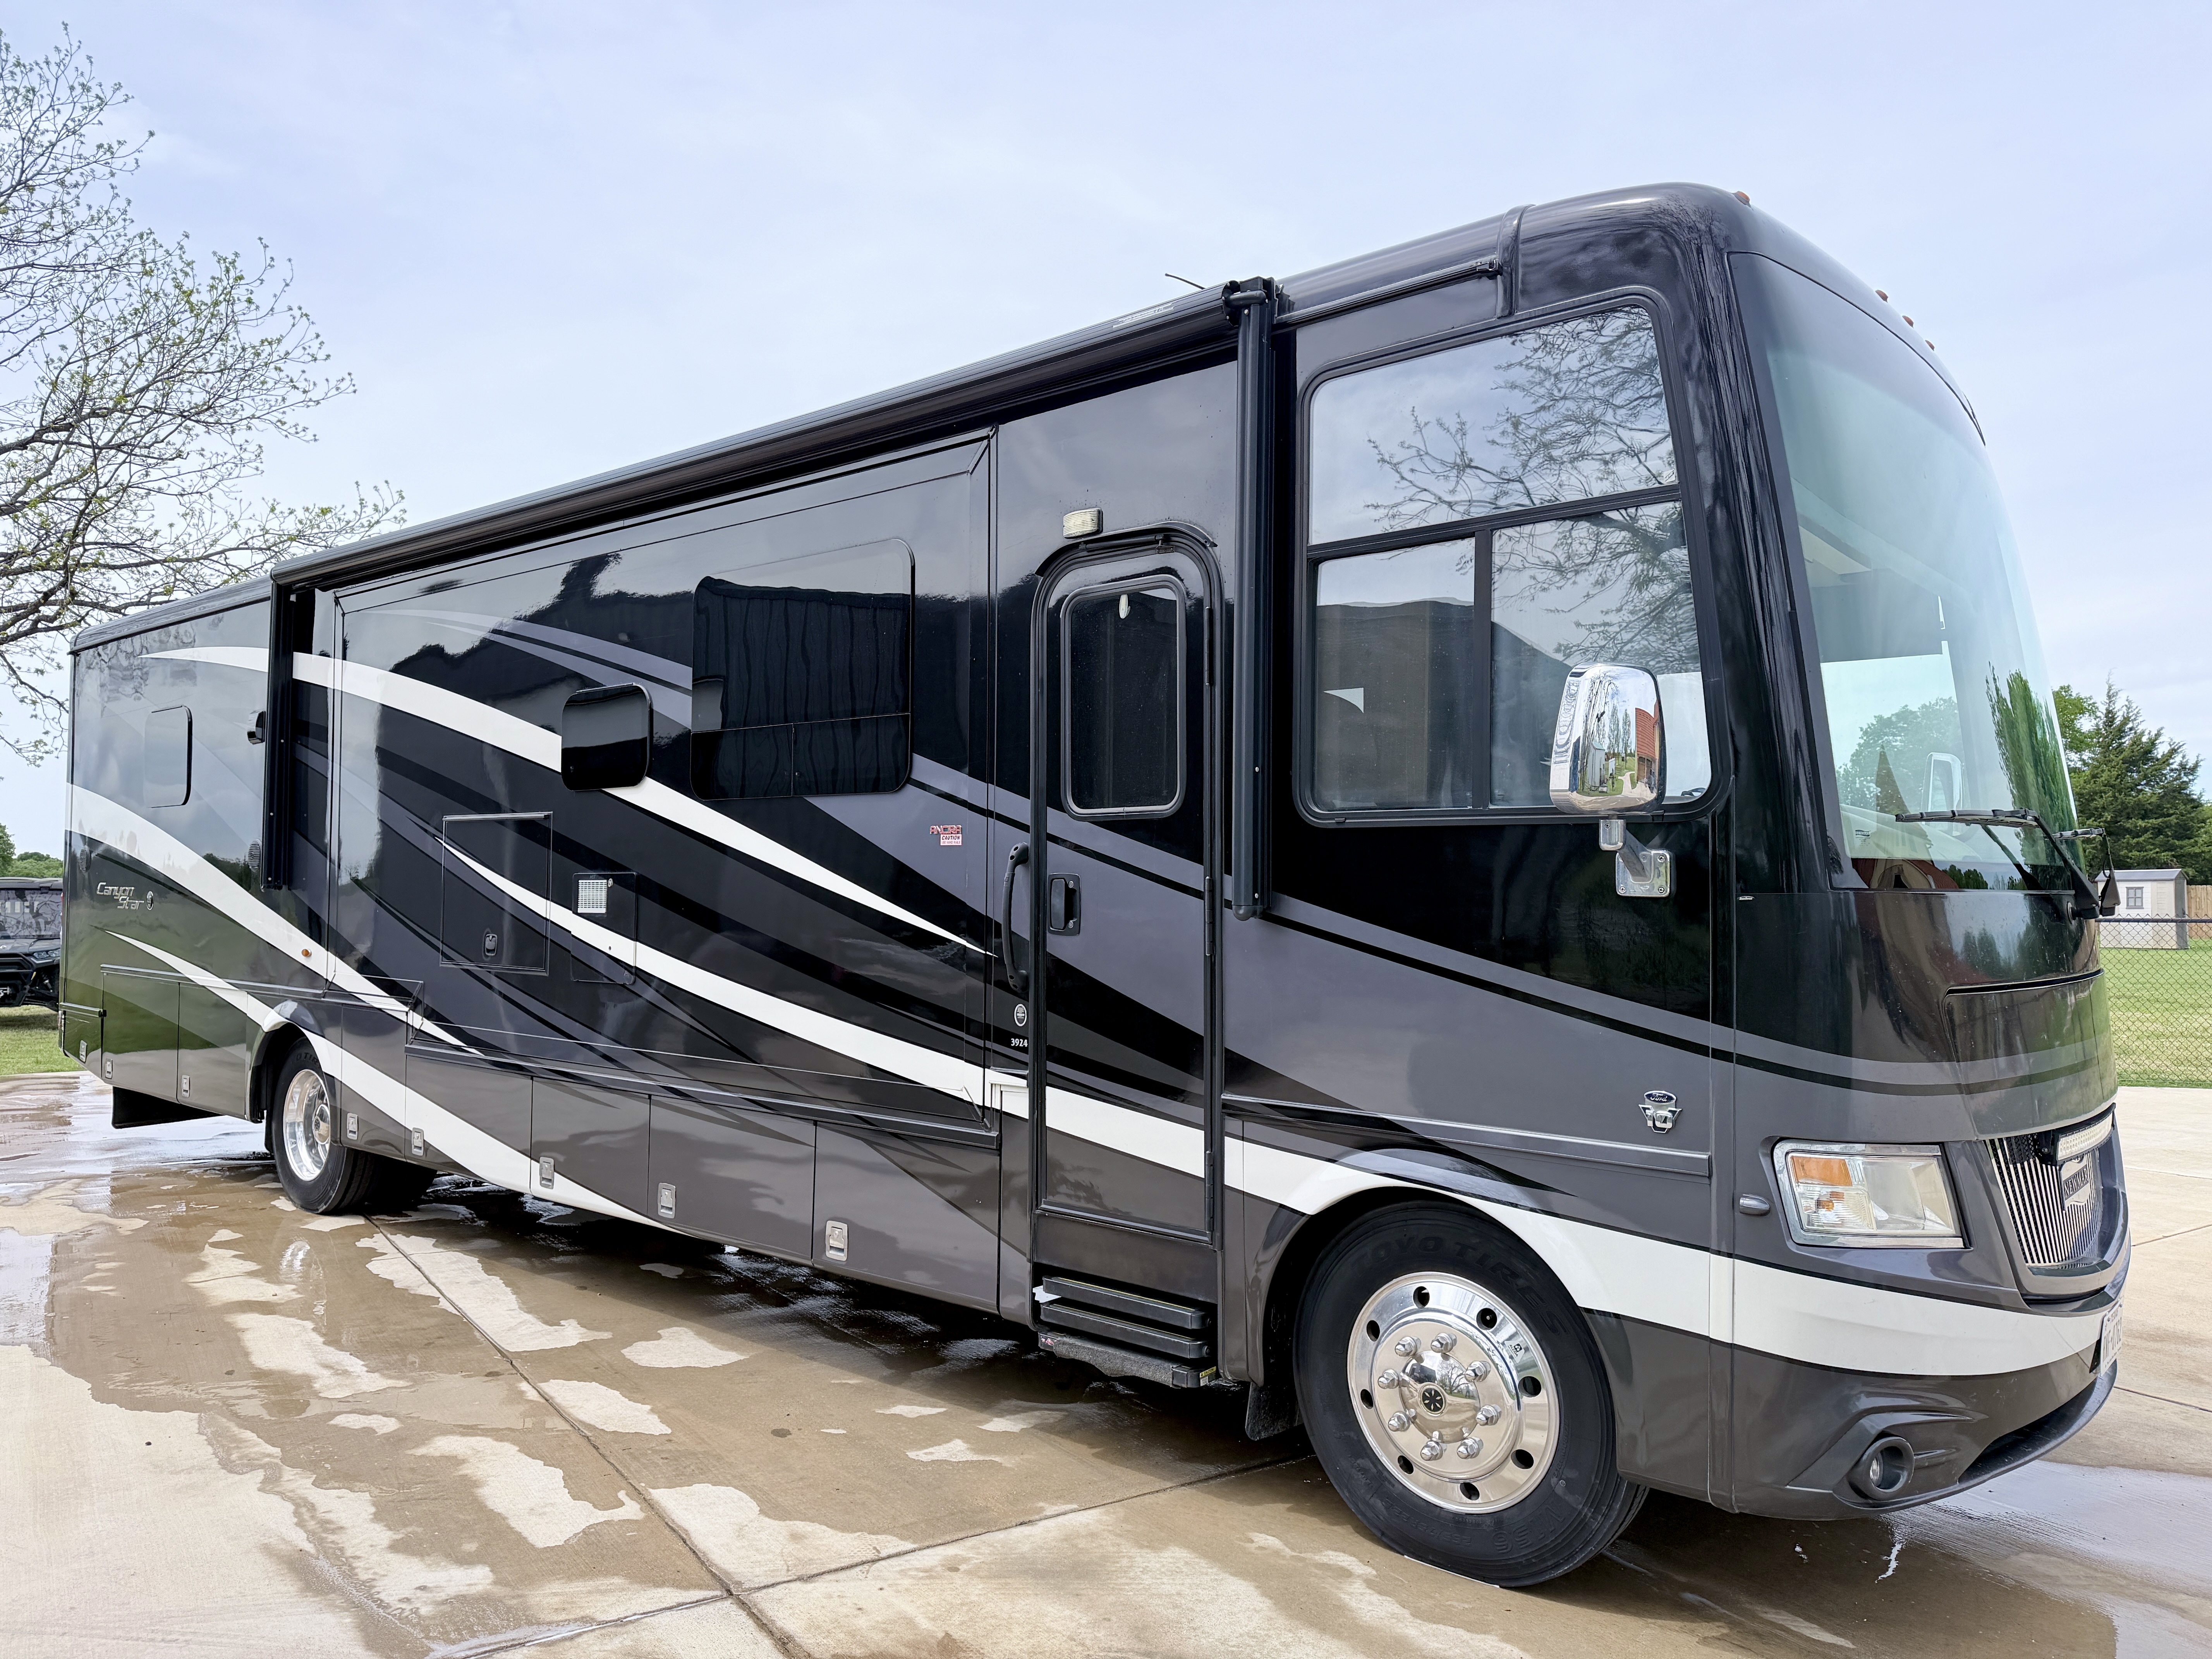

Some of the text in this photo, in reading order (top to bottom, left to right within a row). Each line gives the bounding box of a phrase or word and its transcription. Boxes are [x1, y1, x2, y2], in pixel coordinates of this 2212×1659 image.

[97, 882, 135, 899] Canyon
[117, 896, 144, 910] Star
[1011, 1038, 1028, 1047] 3924
[1650, 1093, 1667, 1102] Ford
[2064, 1168, 2088, 1198] NEWMAR
[1350, 1235, 1570, 1336] TOYO TIRES
